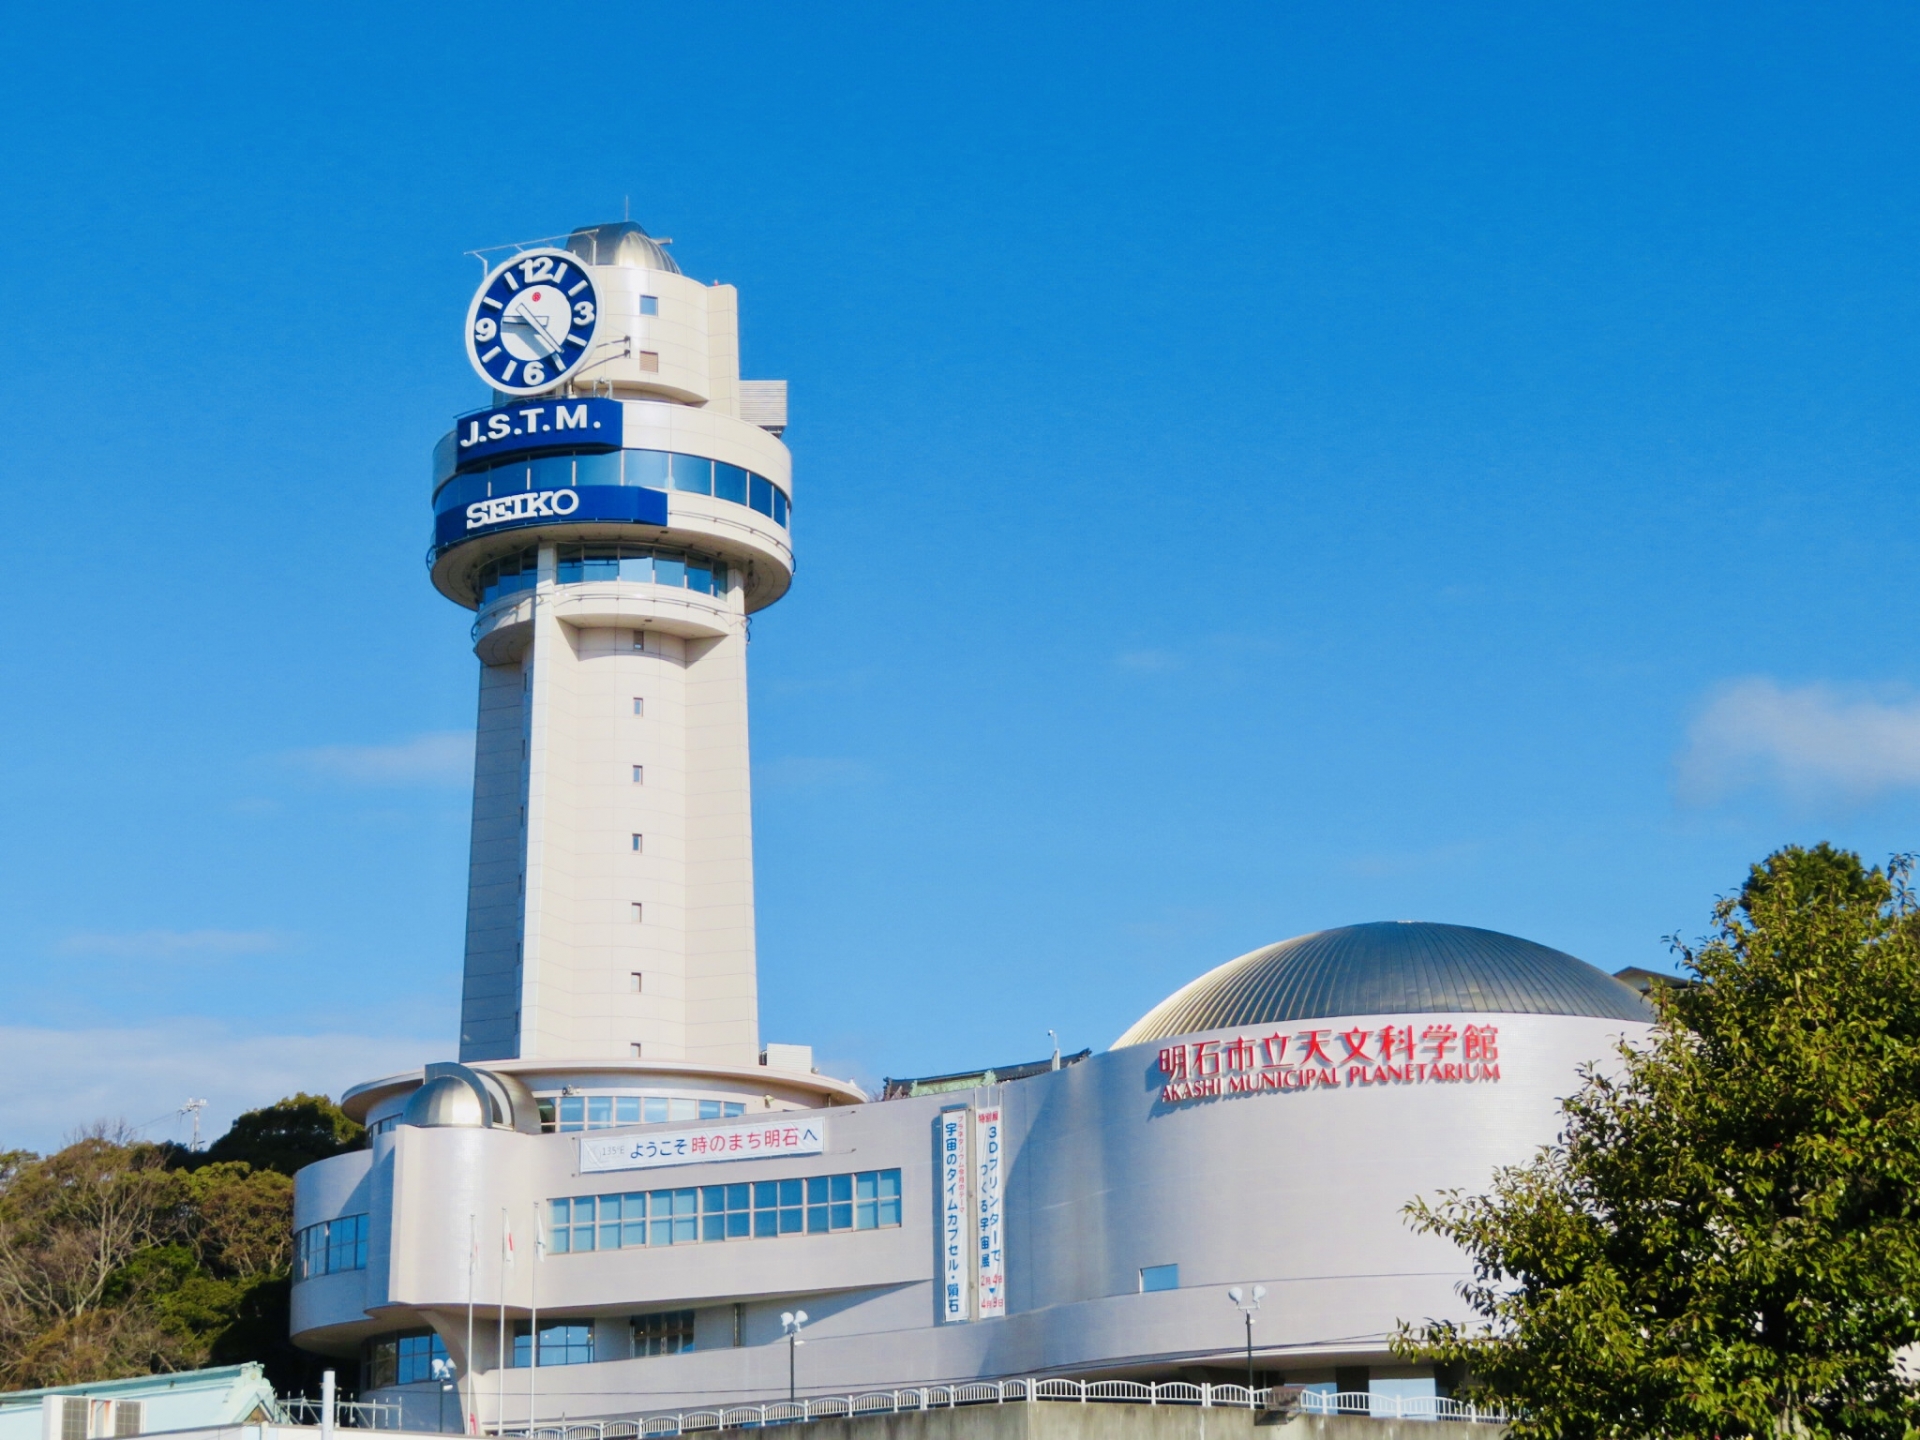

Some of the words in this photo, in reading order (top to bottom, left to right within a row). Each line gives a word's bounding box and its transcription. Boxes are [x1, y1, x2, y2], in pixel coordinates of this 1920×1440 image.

[519, 256, 554, 283] 12
[474, 317, 497, 343] 9
[573, 301, 595, 326] 3
[523, 361, 545, 386] 6
[460, 404, 601, 447] J.S.T.M.
[466, 488, 580, 529] SEIKO
[1159, 1024, 1499, 1082] 明石市立天文科学館
[1162, 1077, 1222, 1103] AKASHI
[1229, 1066, 1341, 1094] MUNICIPAL
[1350, 1062, 1501, 1084] PLANETARIUM
